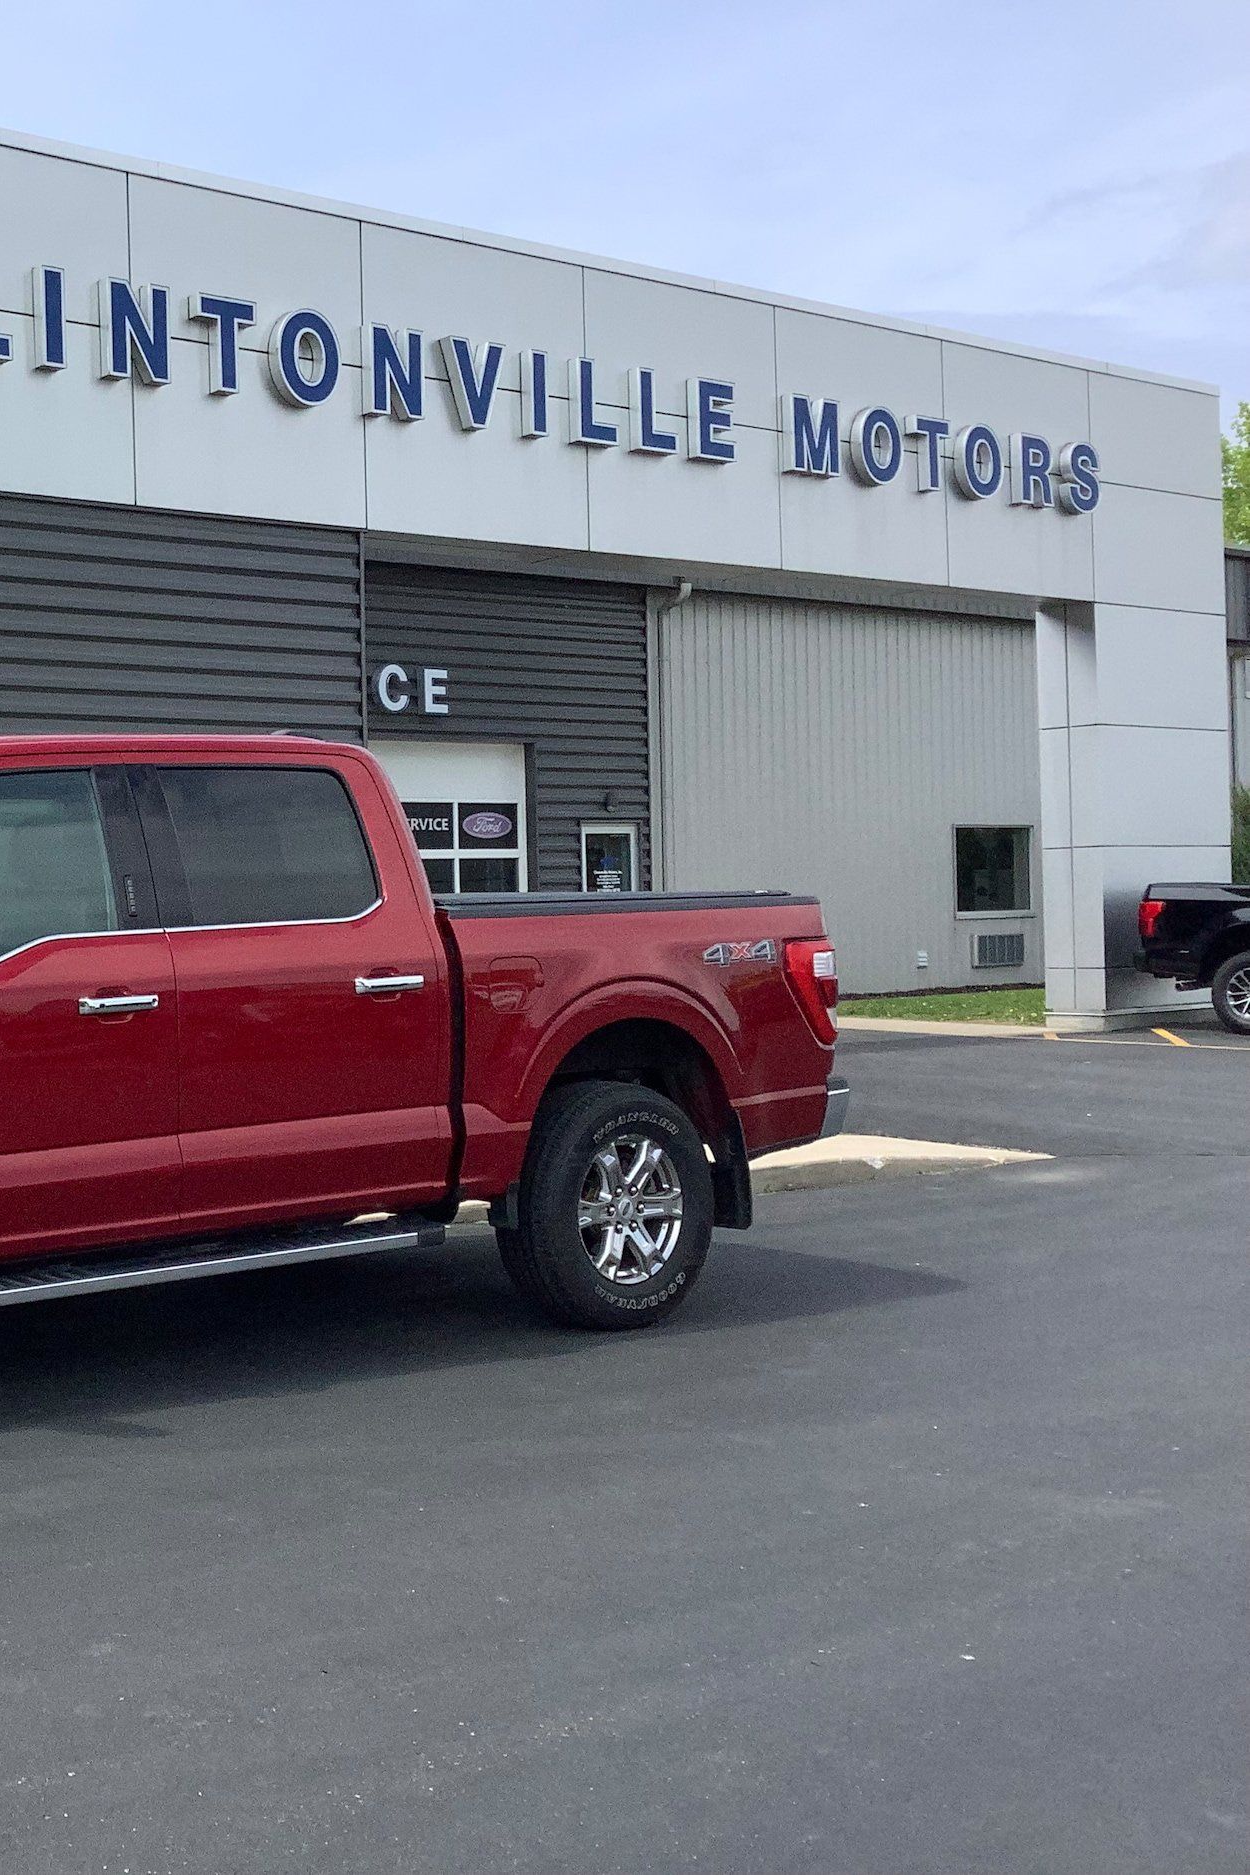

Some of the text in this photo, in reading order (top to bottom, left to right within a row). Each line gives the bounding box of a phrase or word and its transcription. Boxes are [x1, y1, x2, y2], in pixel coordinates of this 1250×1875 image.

[781, 393, 1100, 515] MOTORS
[378, 664, 449, 714] CE
[593, 1112, 680, 1143] WRANGLER
